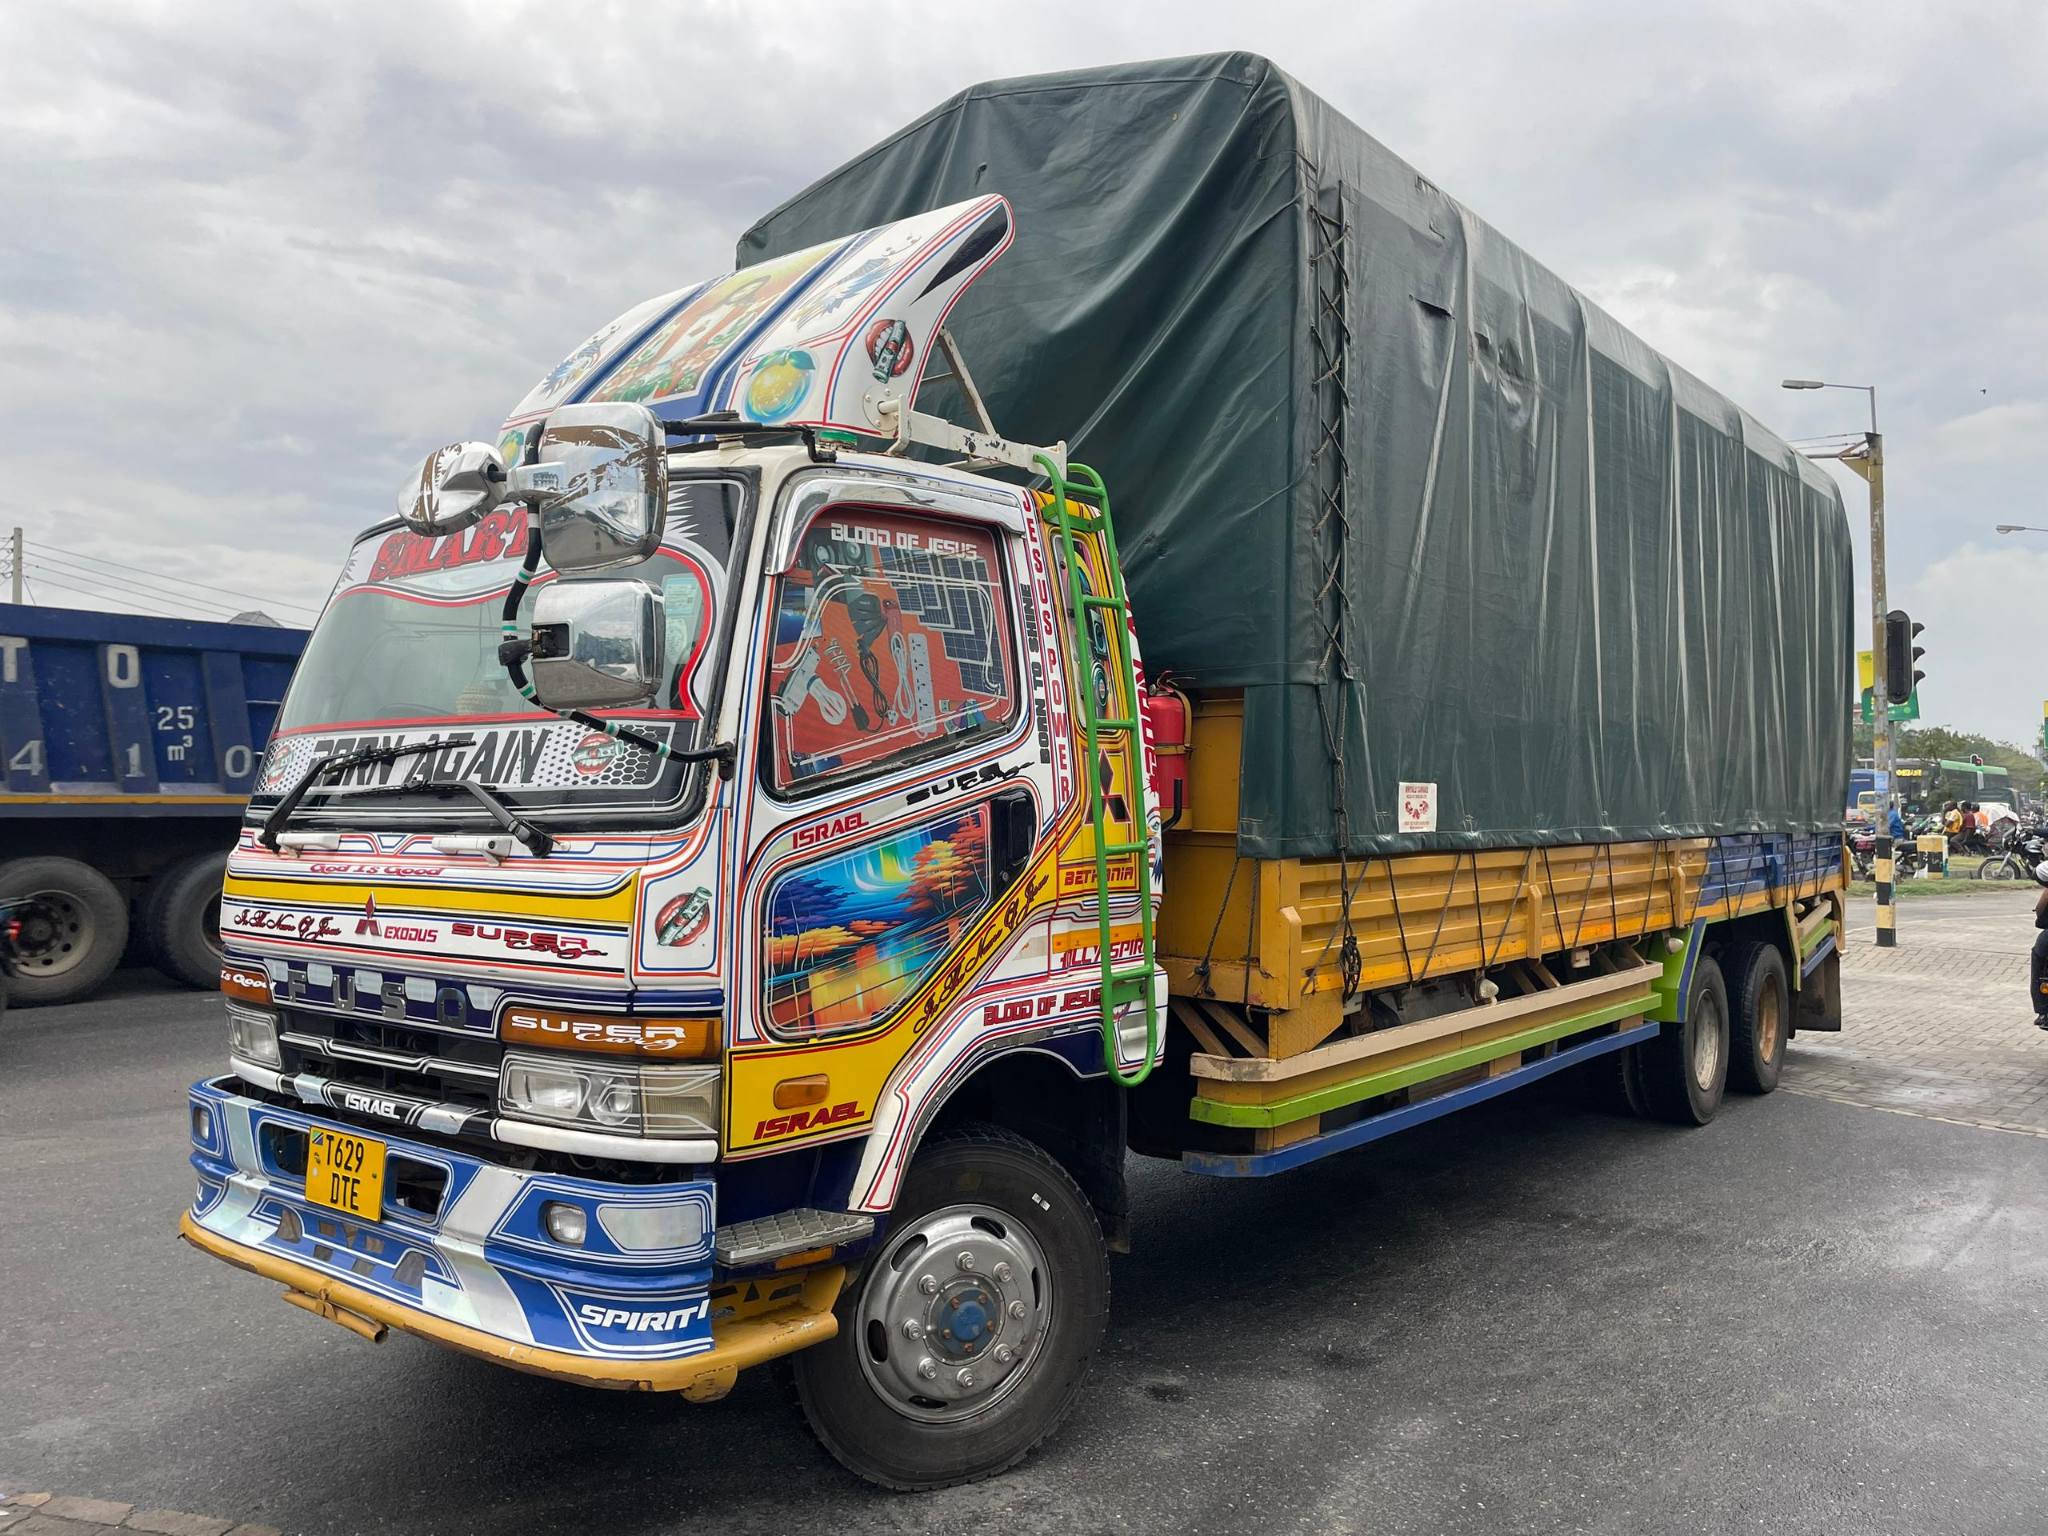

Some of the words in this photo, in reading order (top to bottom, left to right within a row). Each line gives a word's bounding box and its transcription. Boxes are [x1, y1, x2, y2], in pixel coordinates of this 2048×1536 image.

[830, 522, 890, 547] BLOOD
[896, 532, 919, 550] OF
[925, 537, 977, 560] JESUS
[1020, 583, 1039, 653] SHINE
[1031, 661, 1043, 691] TO
[157, 706, 194, 730] 25
[1033, 698, 1051, 764] BORN
[792, 812, 869, 849] ISRAEL
[310, 863, 350, 874] God
[354, 864, 379, 874] Is
[384, 866, 443, 876] Good
[383, 925, 438, 943] EXODUS
[451, 923, 588, 949] SUPER
[287, 969, 467, 1029] FUSO
[984, 999, 1033, 1026] BLOOD
[1037, 995, 1056, 1017] OF
[511, 1015, 686, 1038] SUPER
[345, 1093, 401, 1119] ISRAEL
[753, 1101, 865, 1140] ISRAEL
[325, 1134, 364, 1173] T629
[330, 1172, 360, 1211] DTE
